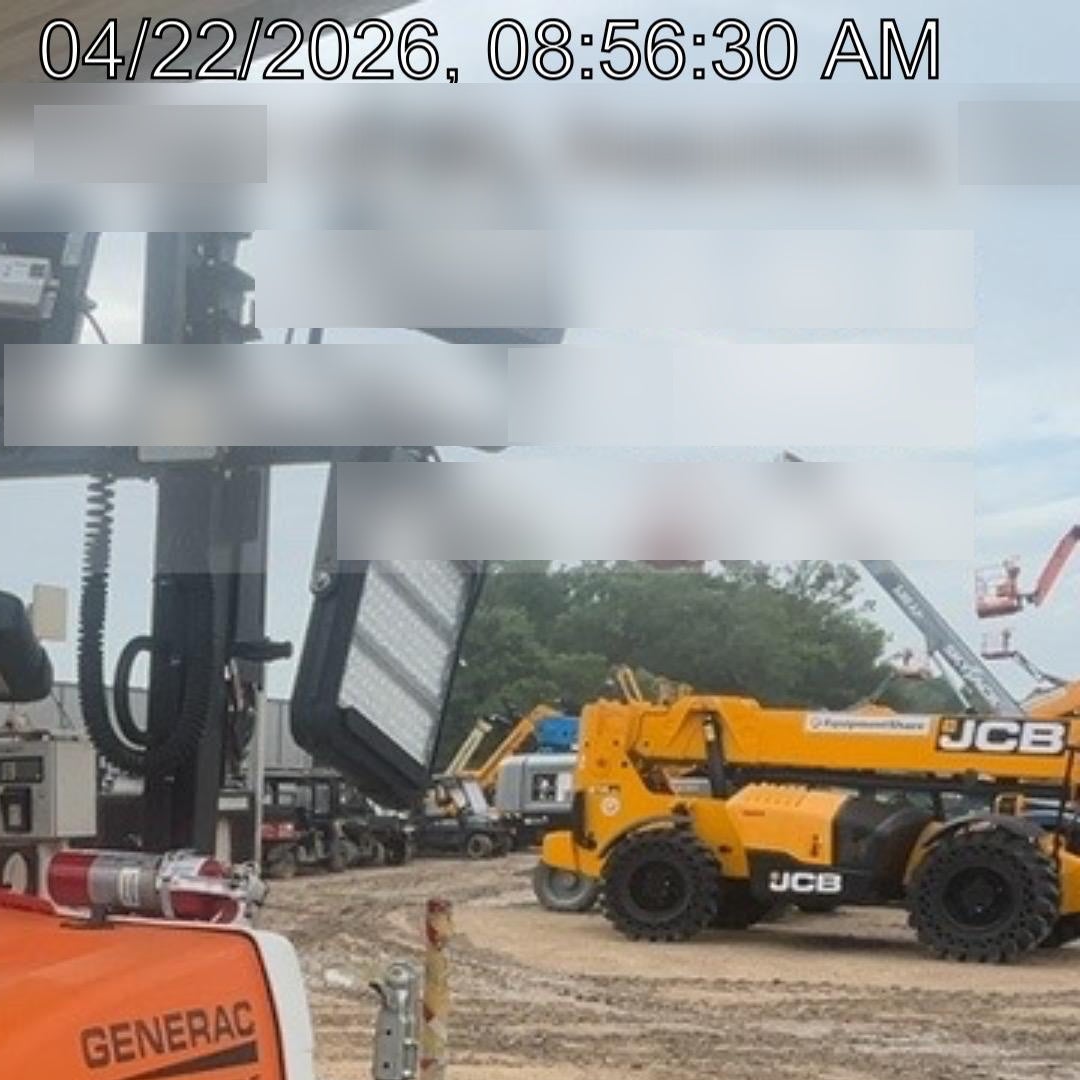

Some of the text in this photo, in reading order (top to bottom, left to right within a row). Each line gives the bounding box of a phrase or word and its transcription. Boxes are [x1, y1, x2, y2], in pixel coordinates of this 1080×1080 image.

[938, 718, 1066, 754] JCB
[769, 871, 842, 892] JCB
[80, 1001, 256, 1069] GENERAC
